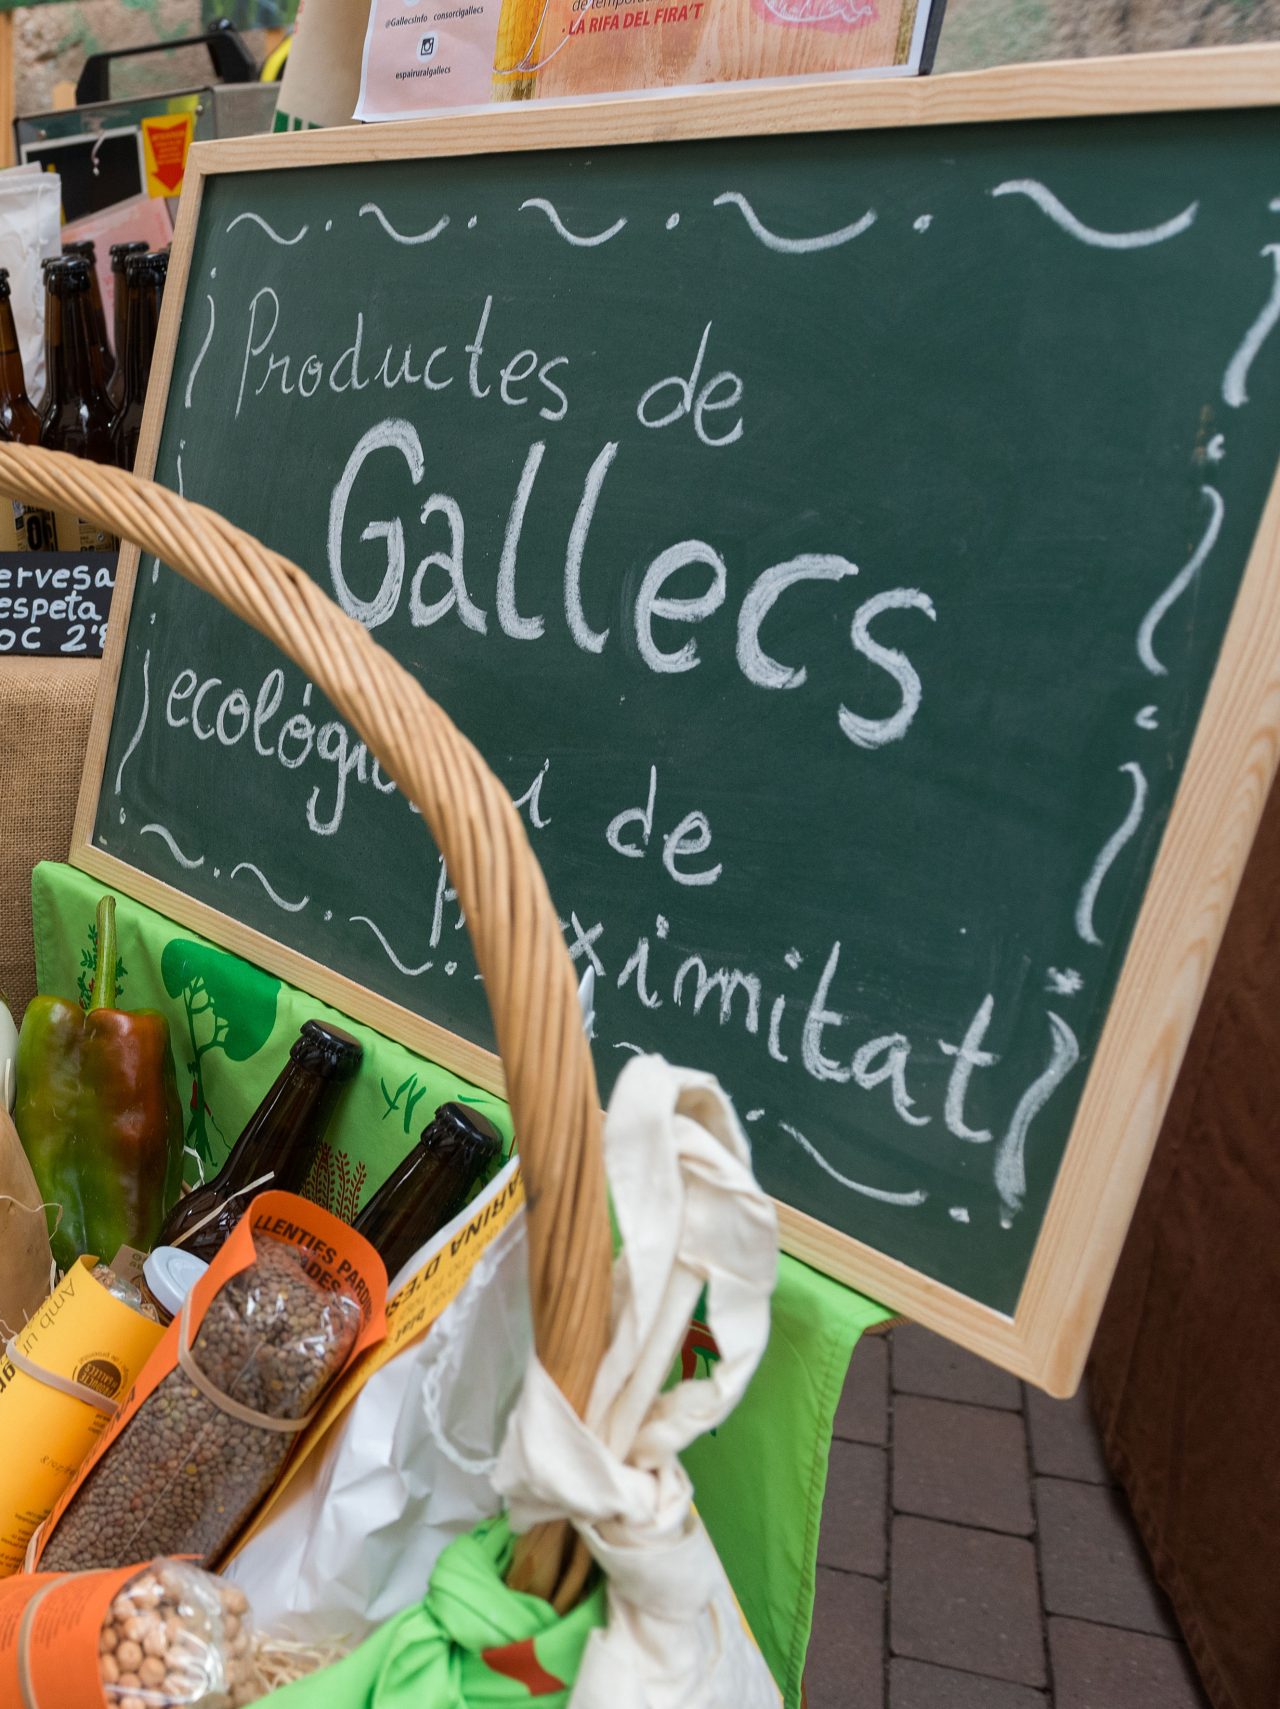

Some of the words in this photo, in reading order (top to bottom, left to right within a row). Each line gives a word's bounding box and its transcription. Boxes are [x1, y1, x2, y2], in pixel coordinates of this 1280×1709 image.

[433, 6, 484, 22] consorcigallecs
[568, 20, 585, 35] LA
[589, 14, 619, 33] RIFA
[623, 10, 651, 29] DEL
[395, 65, 451, 80] espairuralgallecs
[235, 286, 570, 422] Productes
[636, 320, 745, 446] de
[328, 417, 938, 749] Gallecs
[605, 764, 723, 886] de
[254, 1215, 338, 1265] LLENTIES
[38, 1277, 76, 1331] Amb
